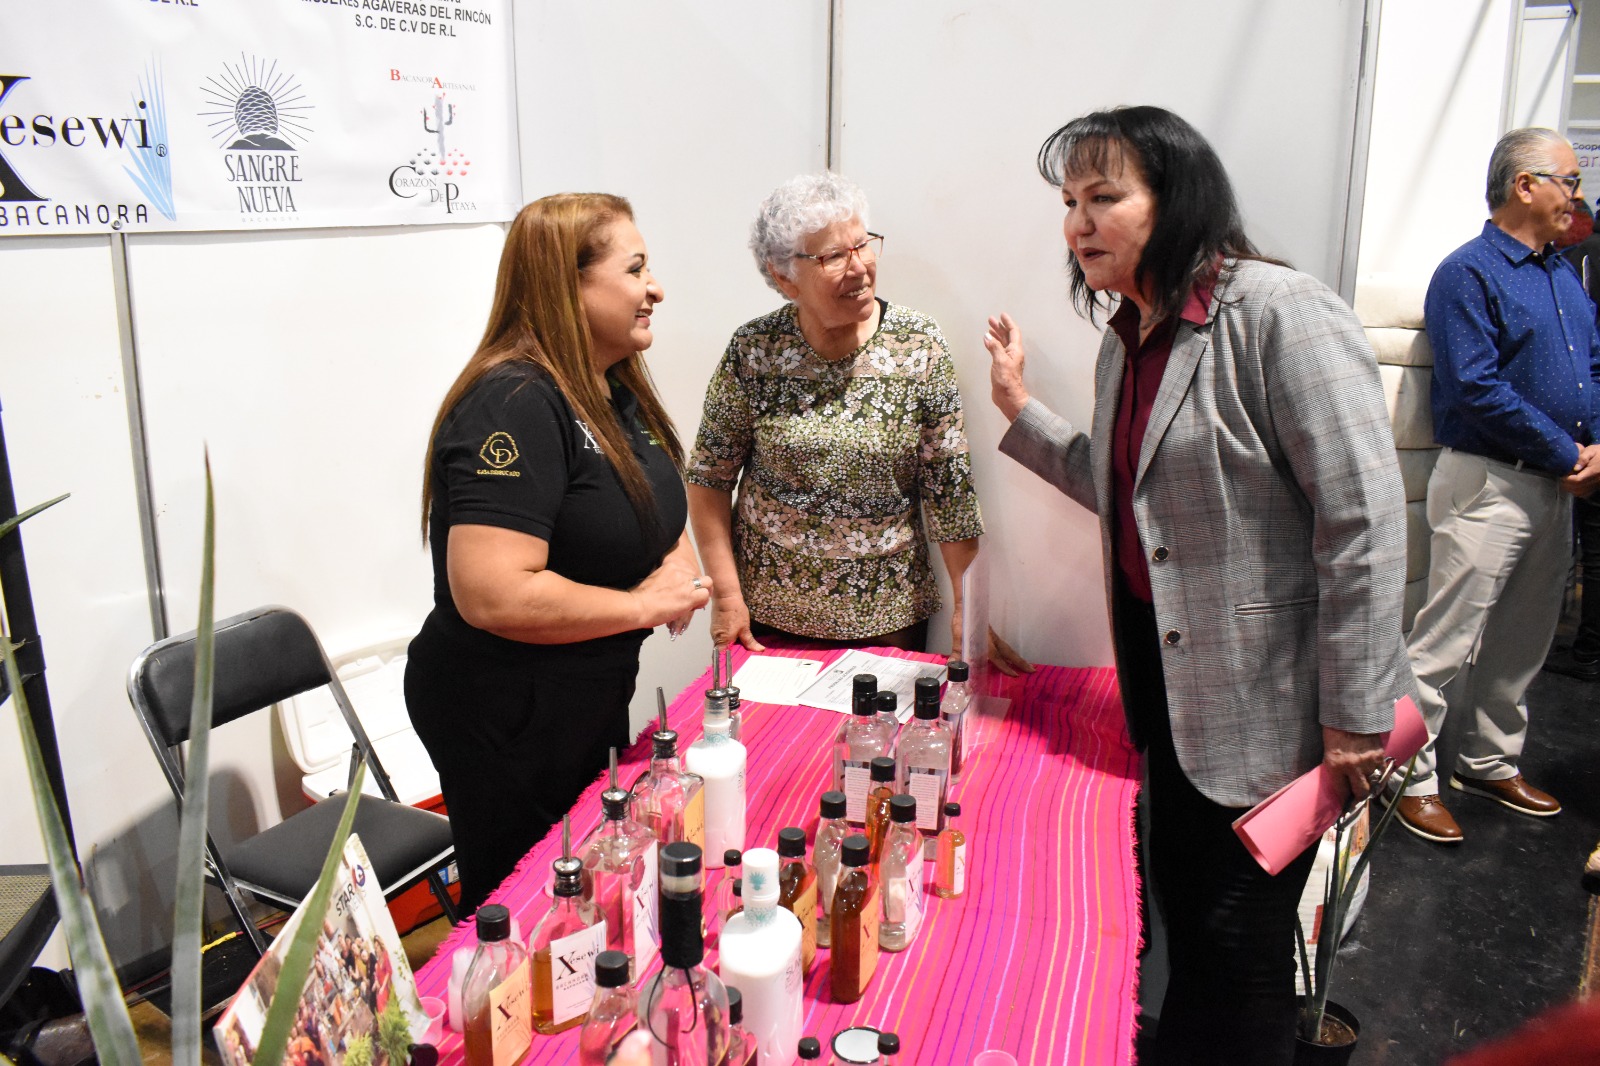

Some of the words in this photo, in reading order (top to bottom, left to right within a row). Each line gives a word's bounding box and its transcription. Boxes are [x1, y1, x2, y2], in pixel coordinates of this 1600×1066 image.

[362, 0, 427, 16] AGAVERAS
[430, 5, 451, 19] DEL
[454, 8, 492, 25] RINCÓN
[355, 14, 377, 29] S.C.
[380, 17, 396, 31] DE
[399, 19, 418, 33] C.V
[421, 22, 436, 35] DE
[439, 24, 457, 37] R.L
[224, 153, 303, 182] SANGRE
[236, 186, 298, 213] NUEVA
[0, 204, 149, 226] BACANORA
